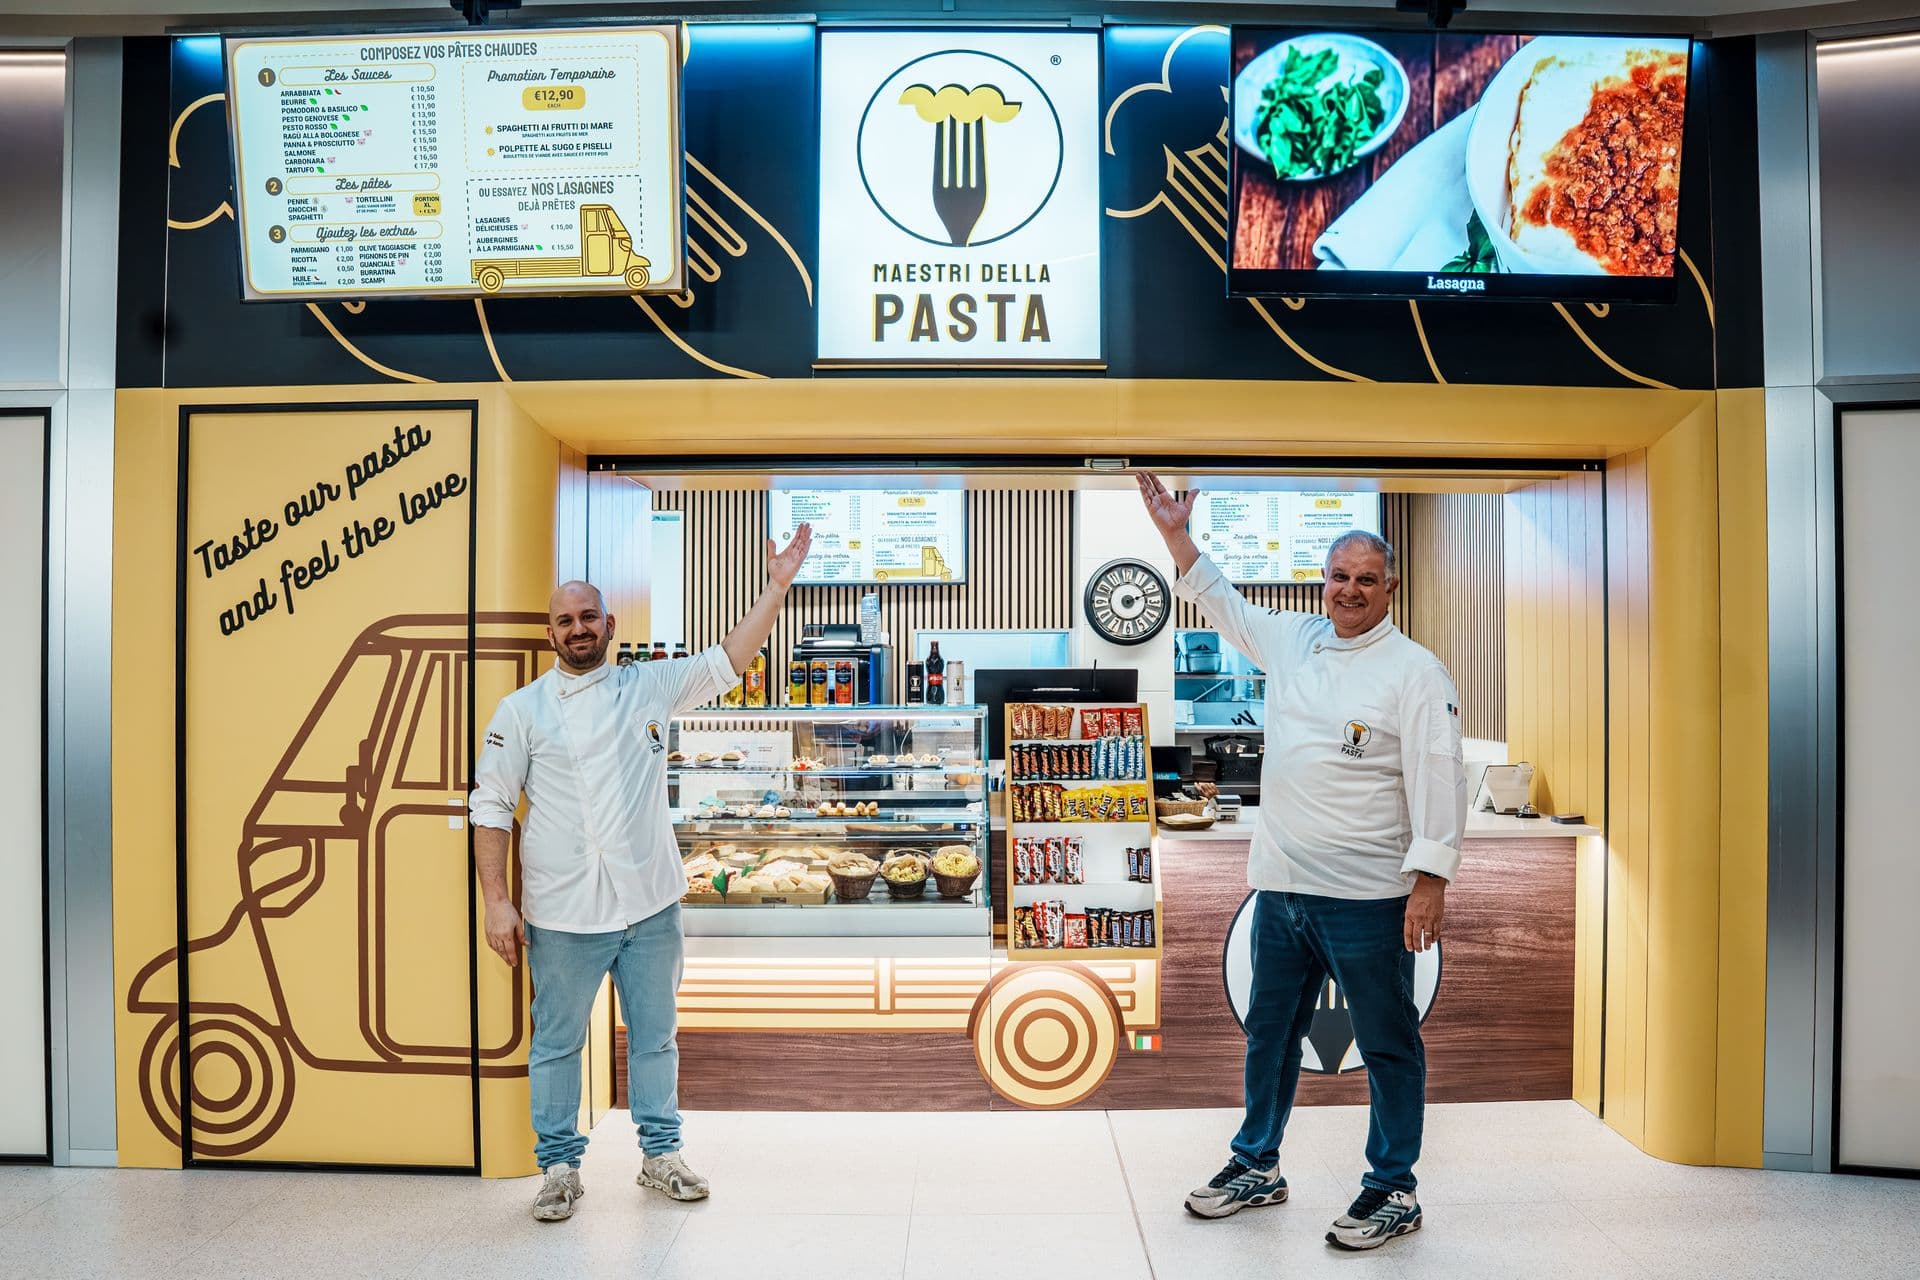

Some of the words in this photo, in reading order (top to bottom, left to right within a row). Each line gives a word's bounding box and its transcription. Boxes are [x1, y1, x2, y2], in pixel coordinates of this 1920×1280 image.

[361, 46, 421, 60] COMPOSEZ
[424, 45, 445, 58] VOS
[448, 42, 481, 58] PÂTES
[485, 42, 537, 57] CHAUDES
[325, 70, 348, 81] Les
[352, 68, 392, 80] Sauces
[488, 69, 546, 82] Promotion
[550, 68, 616, 82] Temporaire
[534, 90, 574, 102] €12,90
[590, 122, 613, 130] MARE
[270, 181, 278, 192] 2
[336, 179, 359, 190] Les
[361, 178, 392, 192] pâtes
[479, 187, 490, 197] OU
[492, 186, 527, 196] ESSAYEZ
[531, 182, 554, 196] NOS
[557, 181, 614, 194] LASAGNES
[518, 200, 540, 211] DEJÀ
[543, 199, 575, 210] PRÊTES
[274, 229, 281, 239] 3
[316, 227, 357, 242] Ajoutez
[360, 226, 376, 237] les
[379, 223, 417, 237] extras
[873, 264, 970, 282] MAESTRI
[981, 264, 1051, 282] DELLA
[1428, 276, 1485, 292] Lasagna
[872, 293, 1051, 342] PASTA
[194, 518, 278, 578] Taste
[284, 482, 340, 526] our
[346, 424, 431, 500] pasta
[219, 578, 277, 635] and
[280, 540, 339, 615] feel
[342, 517, 395, 558] the
[399, 473, 467, 524] love
[1341, 747, 1362, 758] PASTA
